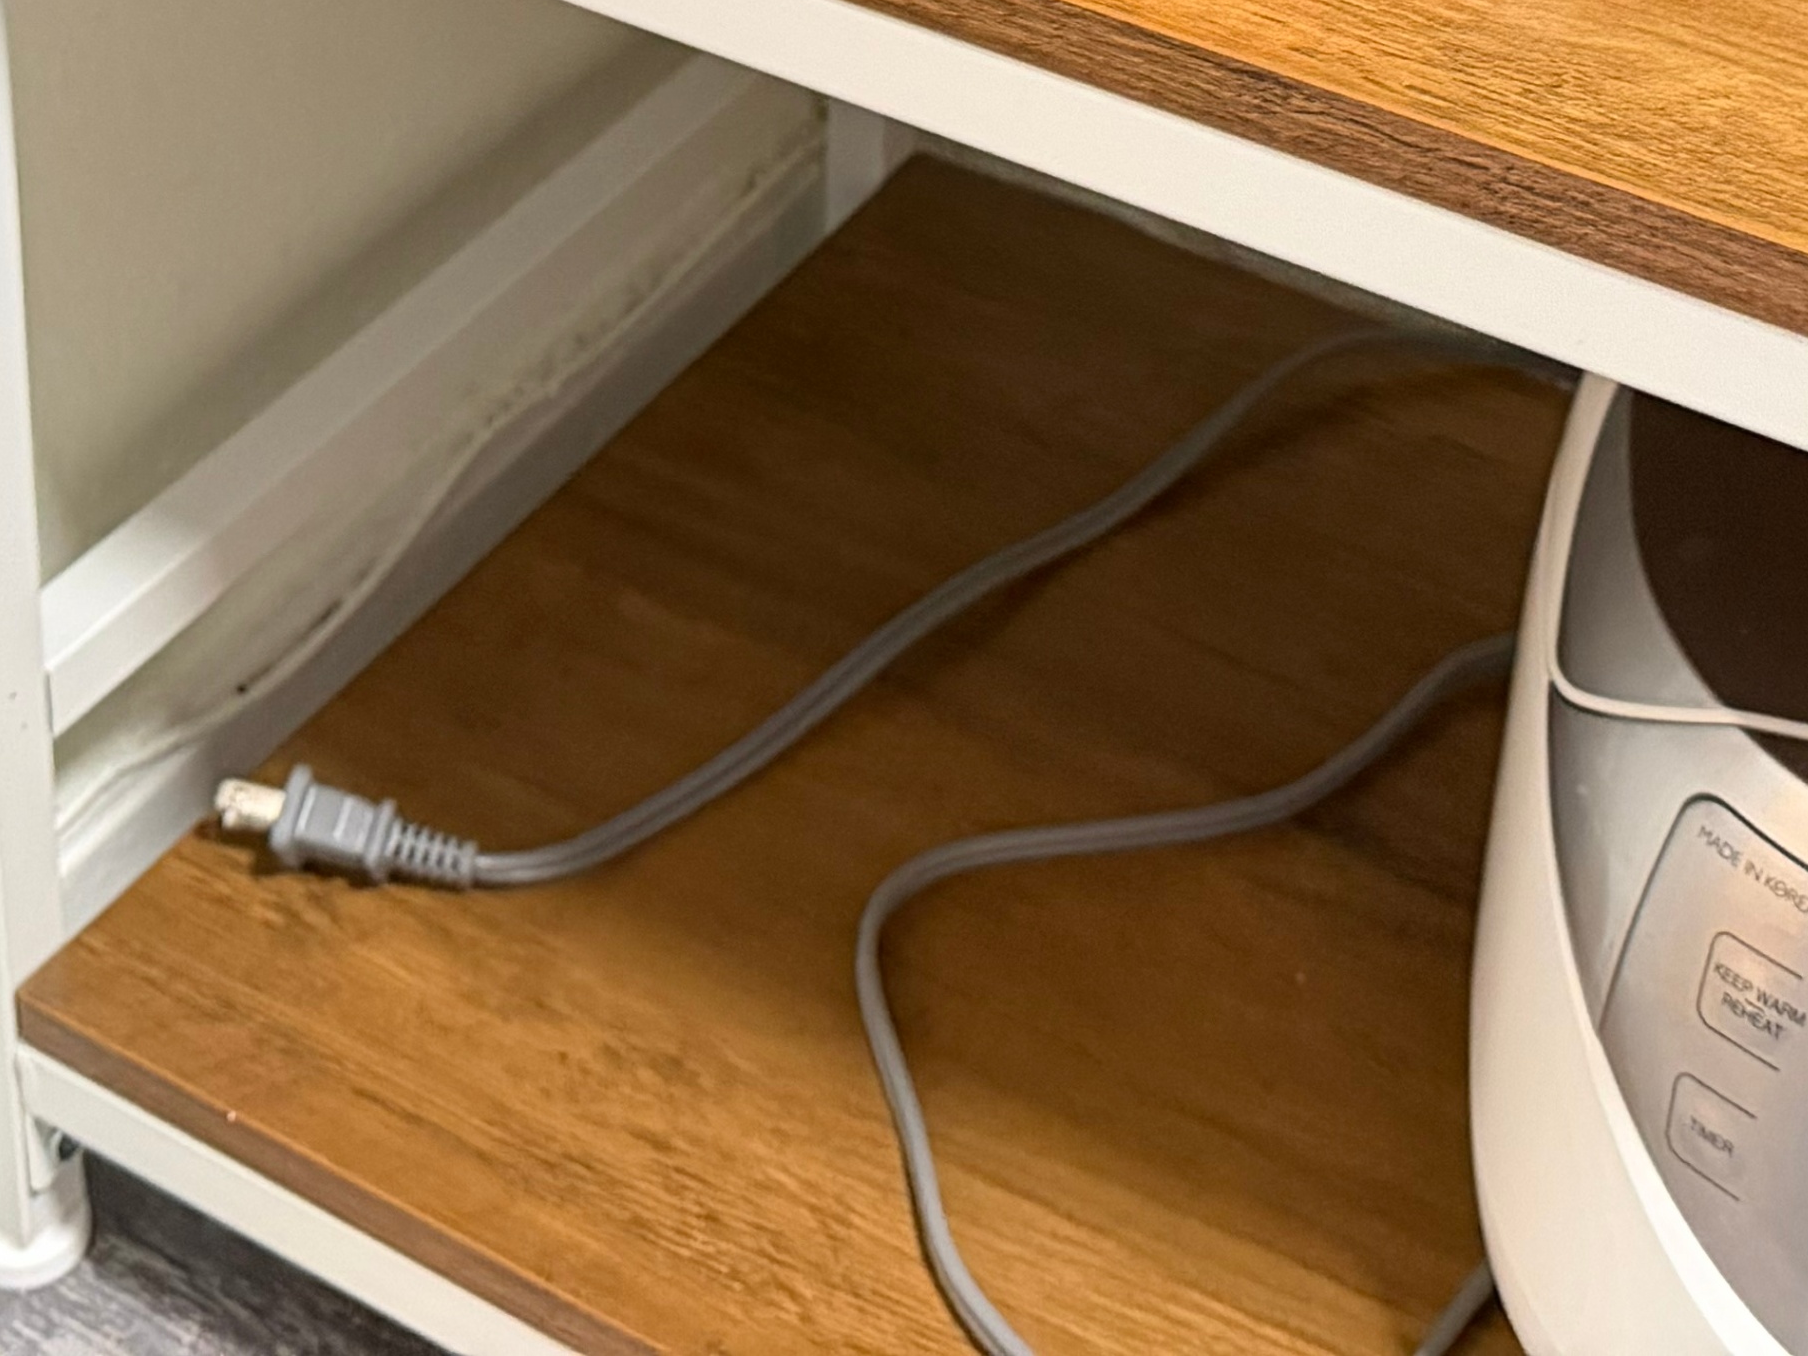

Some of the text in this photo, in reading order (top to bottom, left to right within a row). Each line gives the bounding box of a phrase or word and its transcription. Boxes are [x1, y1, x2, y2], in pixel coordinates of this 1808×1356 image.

[1699, 826, 1746, 871] MADE
[1744, 862, 1765, 884] IN
[1712, 962, 1806, 1028] KEEP WARM
[1720, 995, 1782, 1041] REHEAT
[1688, 1117, 1735, 1157] TIMER
